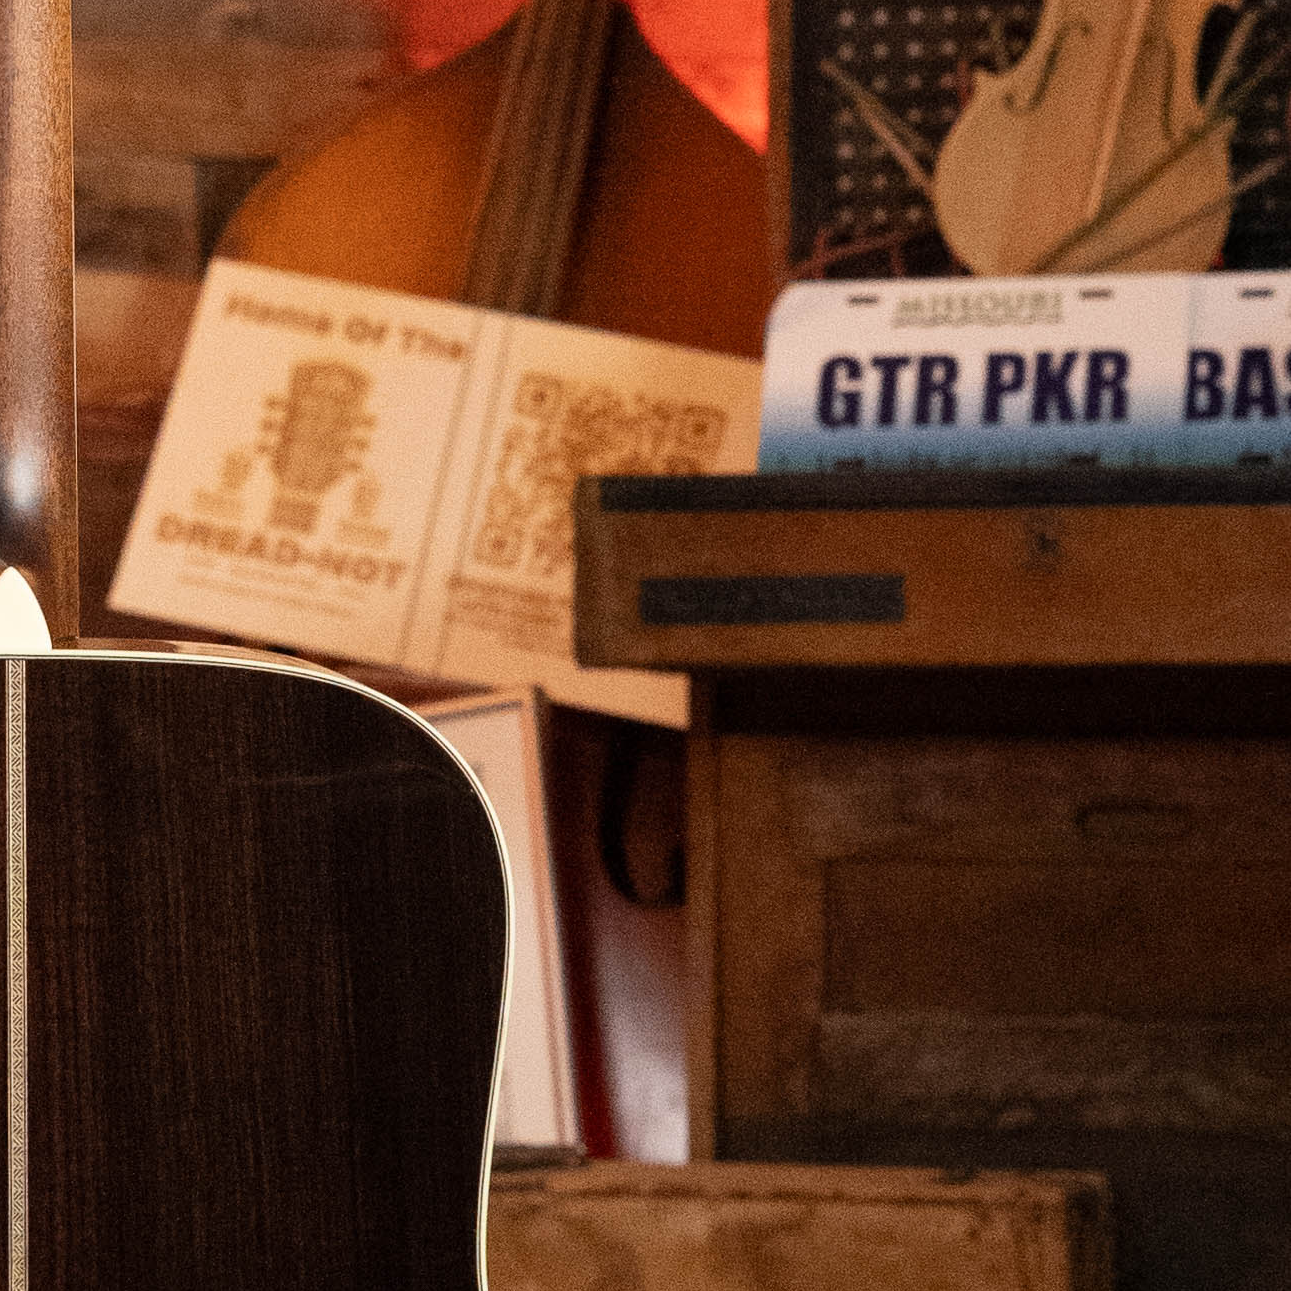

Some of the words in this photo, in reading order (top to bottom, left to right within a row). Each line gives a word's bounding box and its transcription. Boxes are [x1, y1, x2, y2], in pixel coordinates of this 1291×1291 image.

[817, 352, 963, 429] GTR
[980, 349, 1131, 424] PKR
[1184, 347, 1291, 421] BA
